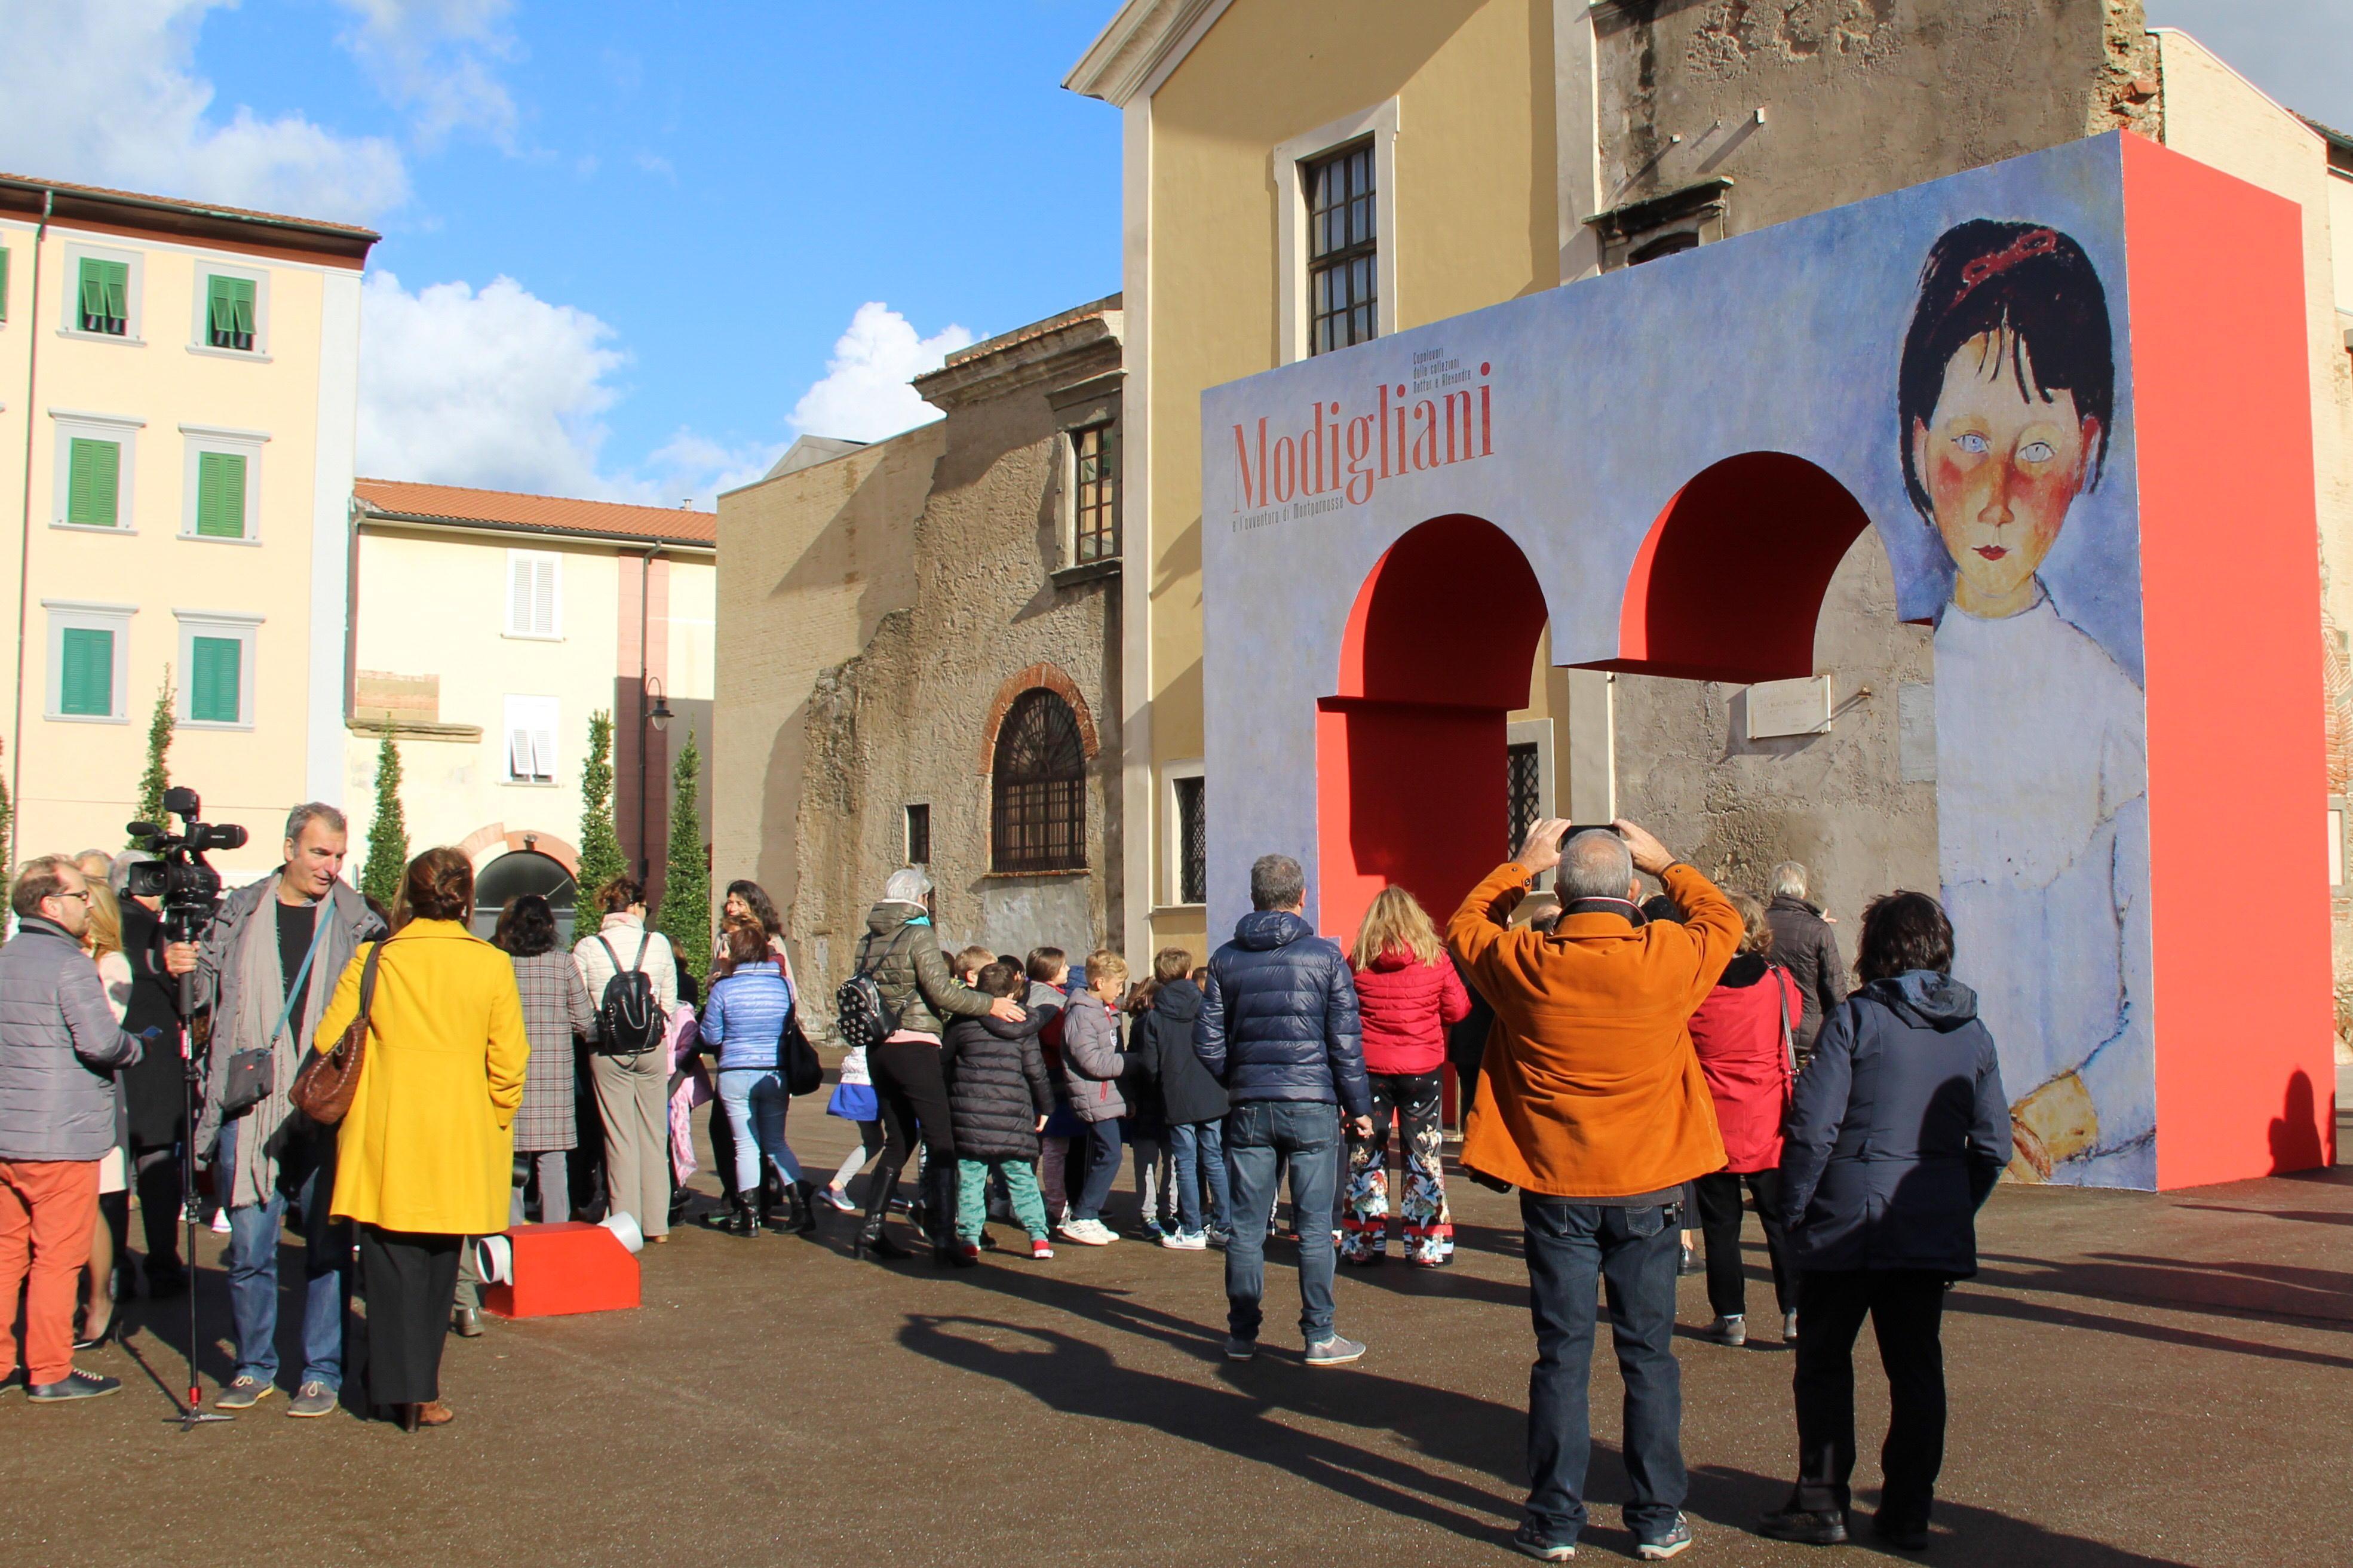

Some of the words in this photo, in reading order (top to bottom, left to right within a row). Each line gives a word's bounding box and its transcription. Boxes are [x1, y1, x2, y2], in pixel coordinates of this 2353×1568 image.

[1413, 345, 1443, 365] Capolavori
[1413, 364, 1427, 379] dalle
[1431, 355, 1459, 375] collezioni
[1435, 378, 1438, 388] e
[1442, 369, 1471, 386] Alexandre
[1232, 362, 1495, 514] Modigliani
[1232, 520, 1237, 533] e
[1240, 510, 1279, 531] l'avventura
[1283, 506, 1290, 521] di
[1293, 496, 1343, 519] Montparnasse
